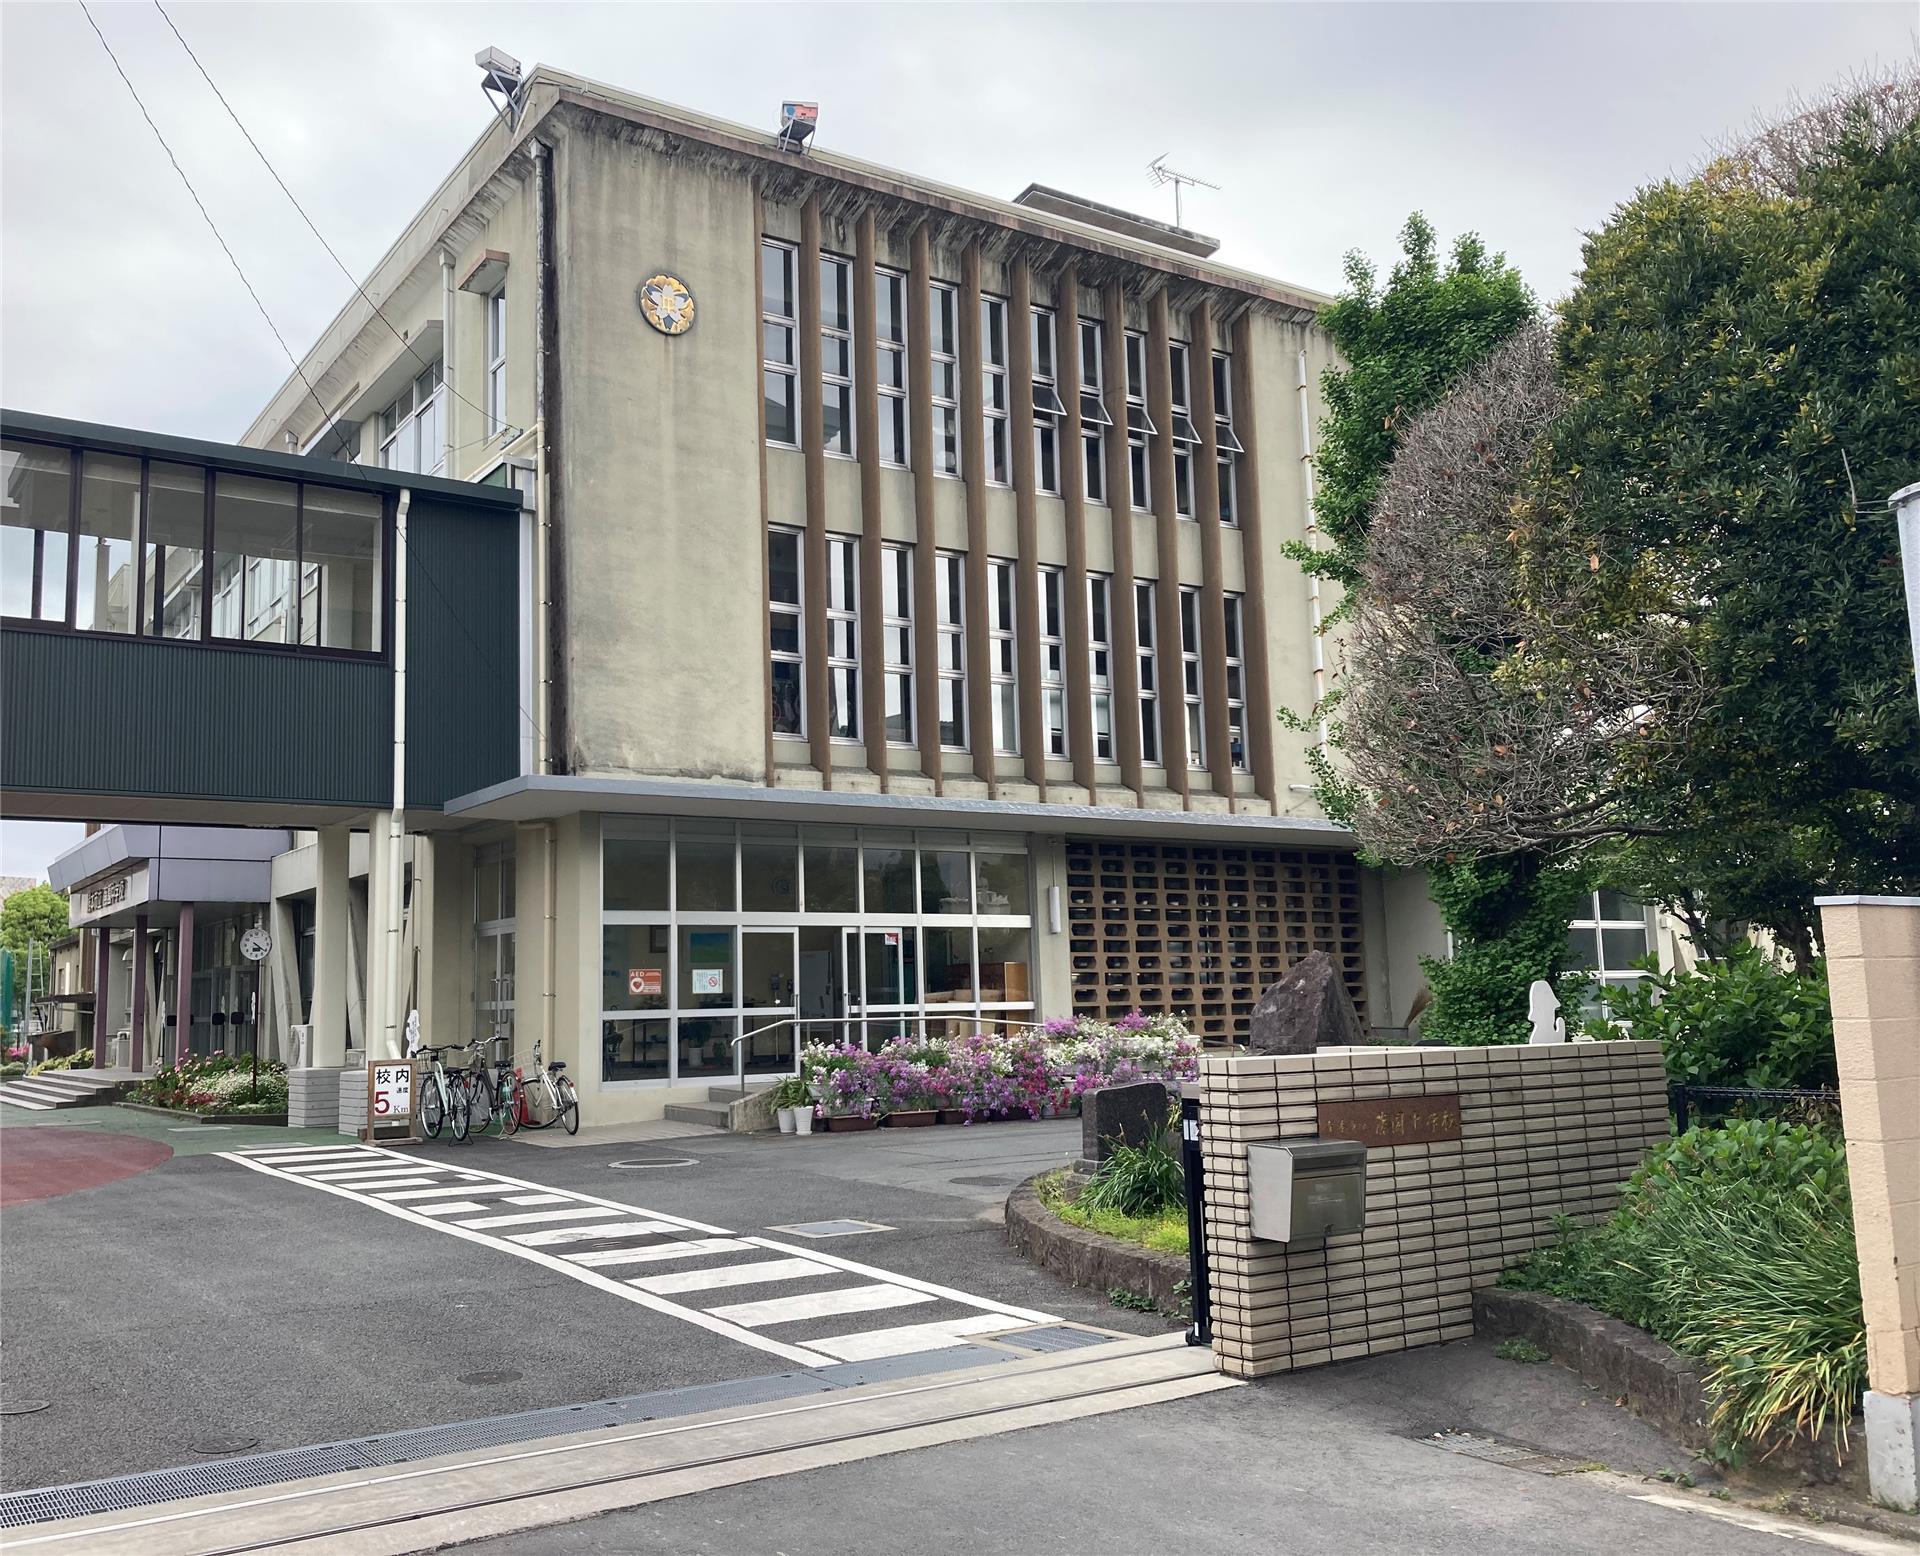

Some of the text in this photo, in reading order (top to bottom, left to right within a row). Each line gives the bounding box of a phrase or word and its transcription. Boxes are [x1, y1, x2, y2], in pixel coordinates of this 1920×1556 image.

[376, 1069, 409, 1084] 校内
[375, 1091, 409, 1114] 5 Km
